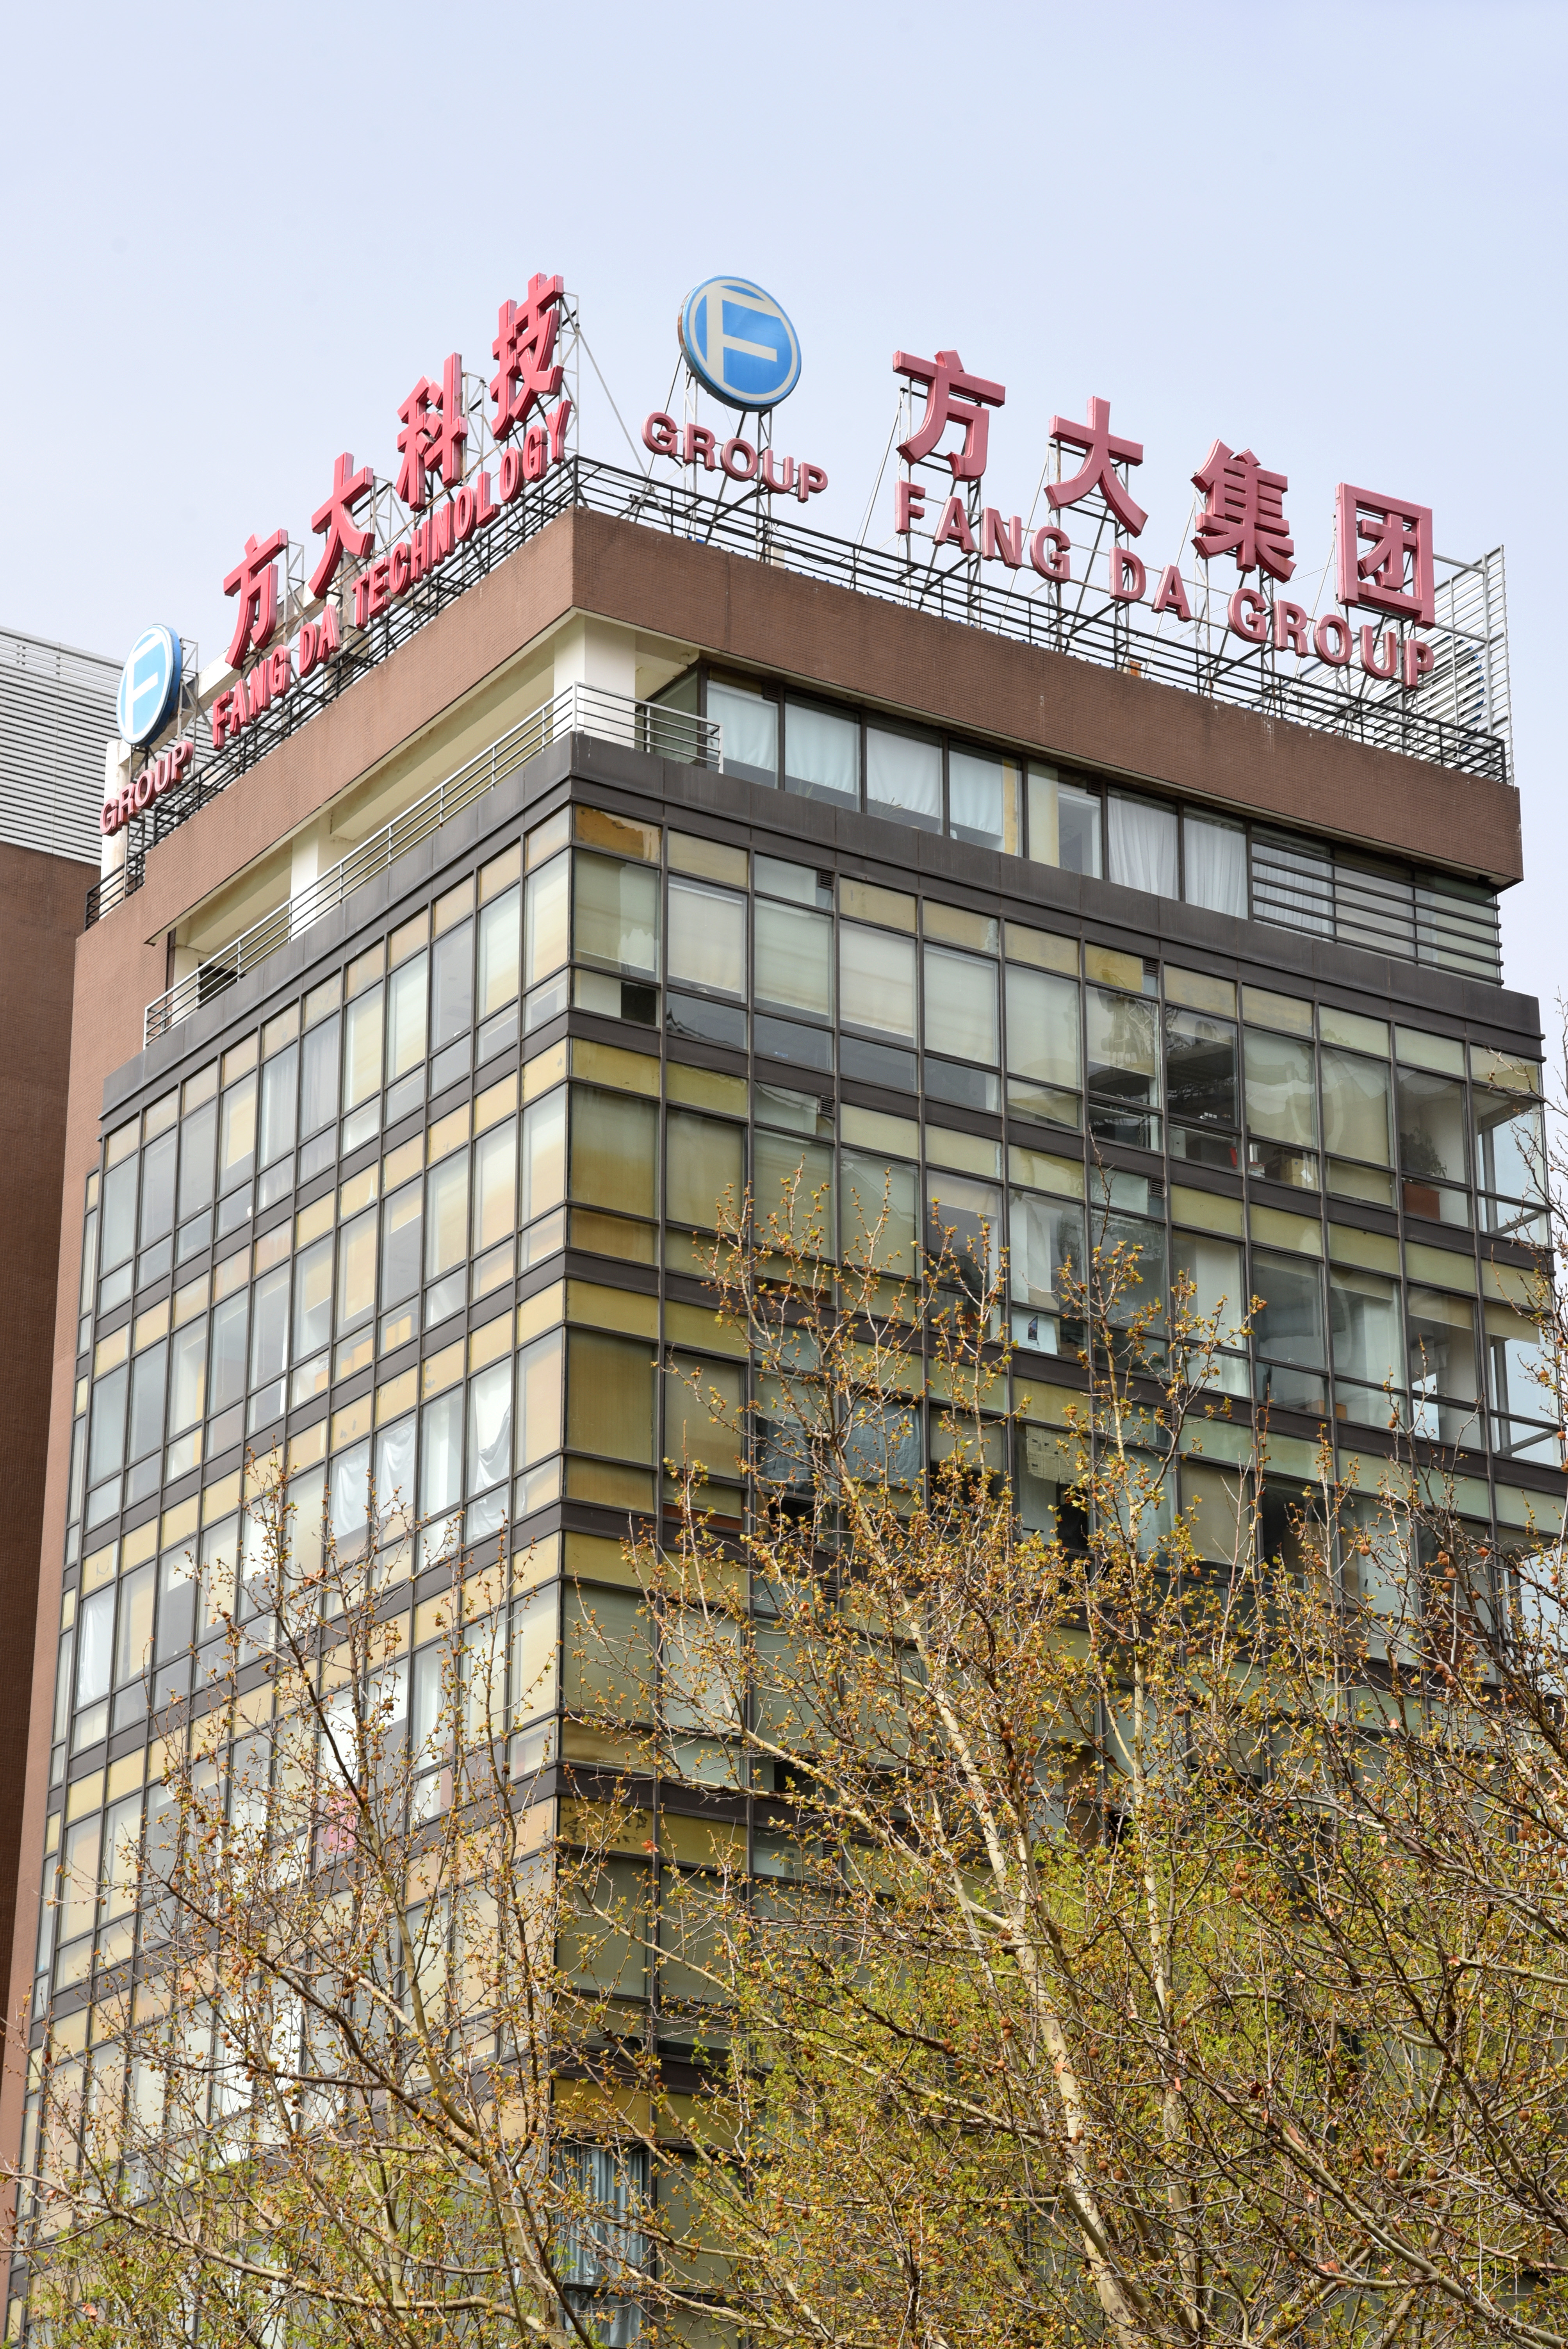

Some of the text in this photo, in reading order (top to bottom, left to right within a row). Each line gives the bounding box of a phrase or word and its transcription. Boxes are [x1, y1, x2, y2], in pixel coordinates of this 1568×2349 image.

[212, 399, 572, 750] FANG DA TECHNOLOGY
[223, 273, 563, 670] 方大科技
[641, 412, 828, 503] GROUP
[893, 350, 1435, 627] 方大集团
[894, 480, 1434, 690] FANG DA GROUP
[99, 741, 194, 836] GROUP
